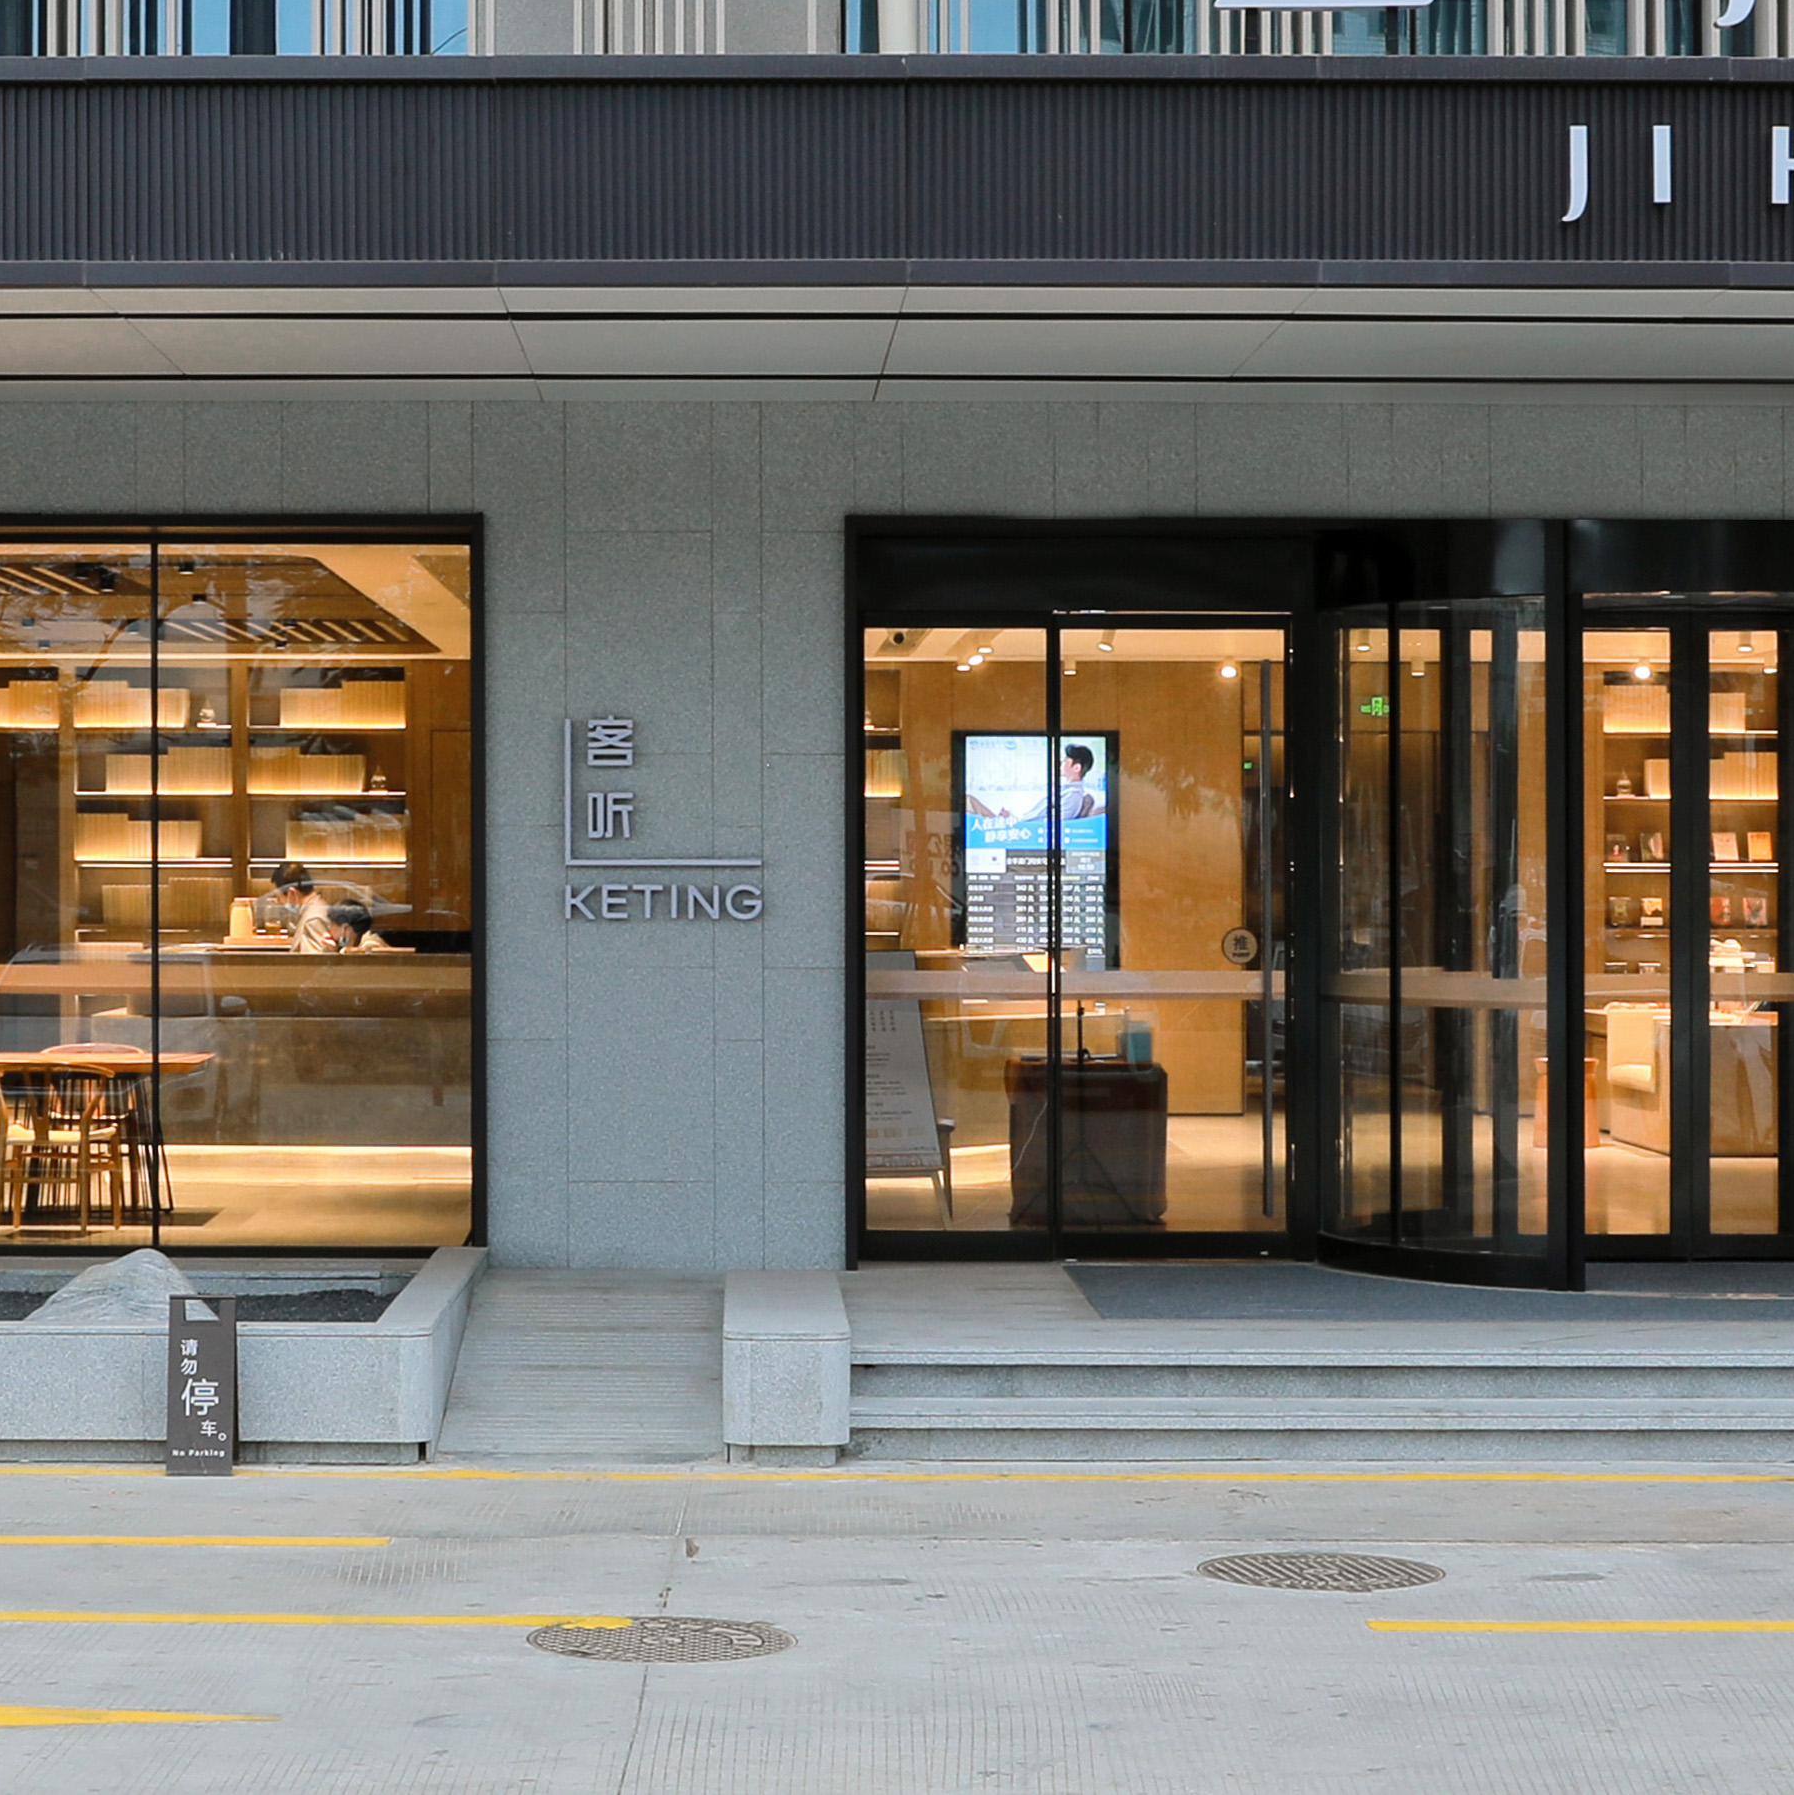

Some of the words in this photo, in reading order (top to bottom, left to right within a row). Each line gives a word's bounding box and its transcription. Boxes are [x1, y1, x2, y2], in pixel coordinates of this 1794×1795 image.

[1561, 124, 1672, 223] JI
[587, 715, 634, 839] 客听
[565, 883, 763, 920] KETING
[1233, 935, 1248, 951] 推
[171, 1449, 185, 1457] No
[188, 1449, 225, 1458] Parking
